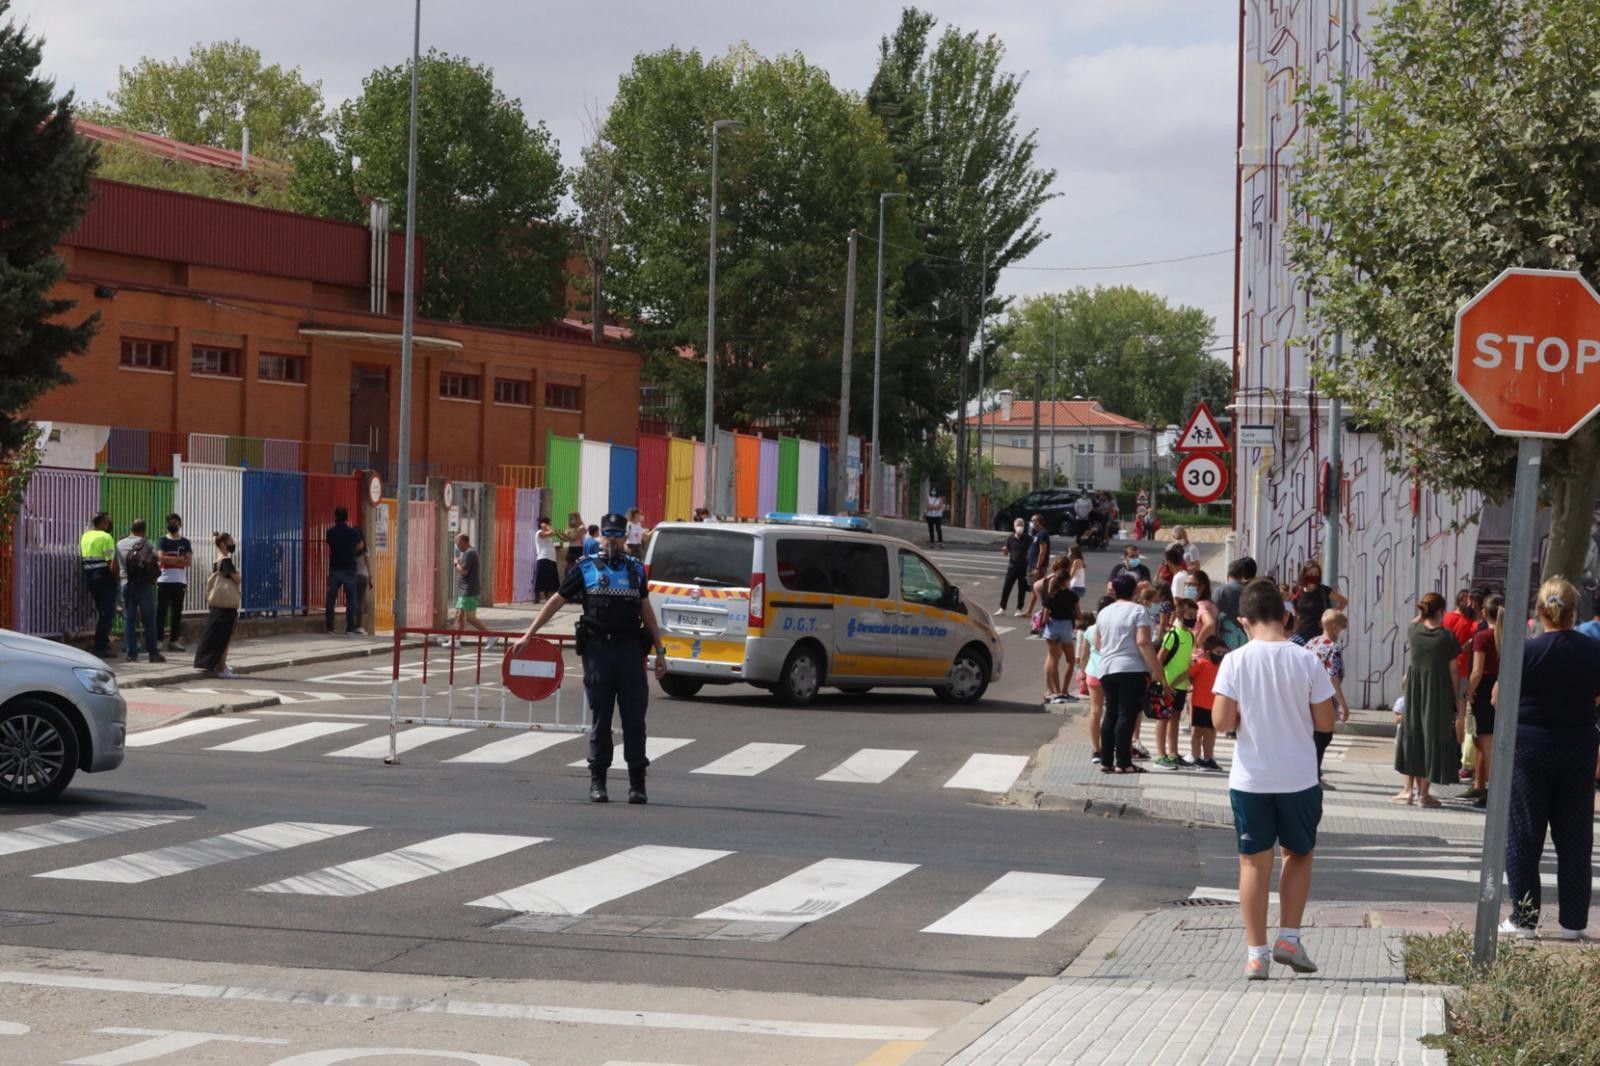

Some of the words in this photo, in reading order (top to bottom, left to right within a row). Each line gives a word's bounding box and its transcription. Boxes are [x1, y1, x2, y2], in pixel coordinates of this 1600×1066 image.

[1472, 332, 1600, 375] STOP
[1188, 469, 1215, 486] 30
[783, 616, 818, 632] D.G.T.
